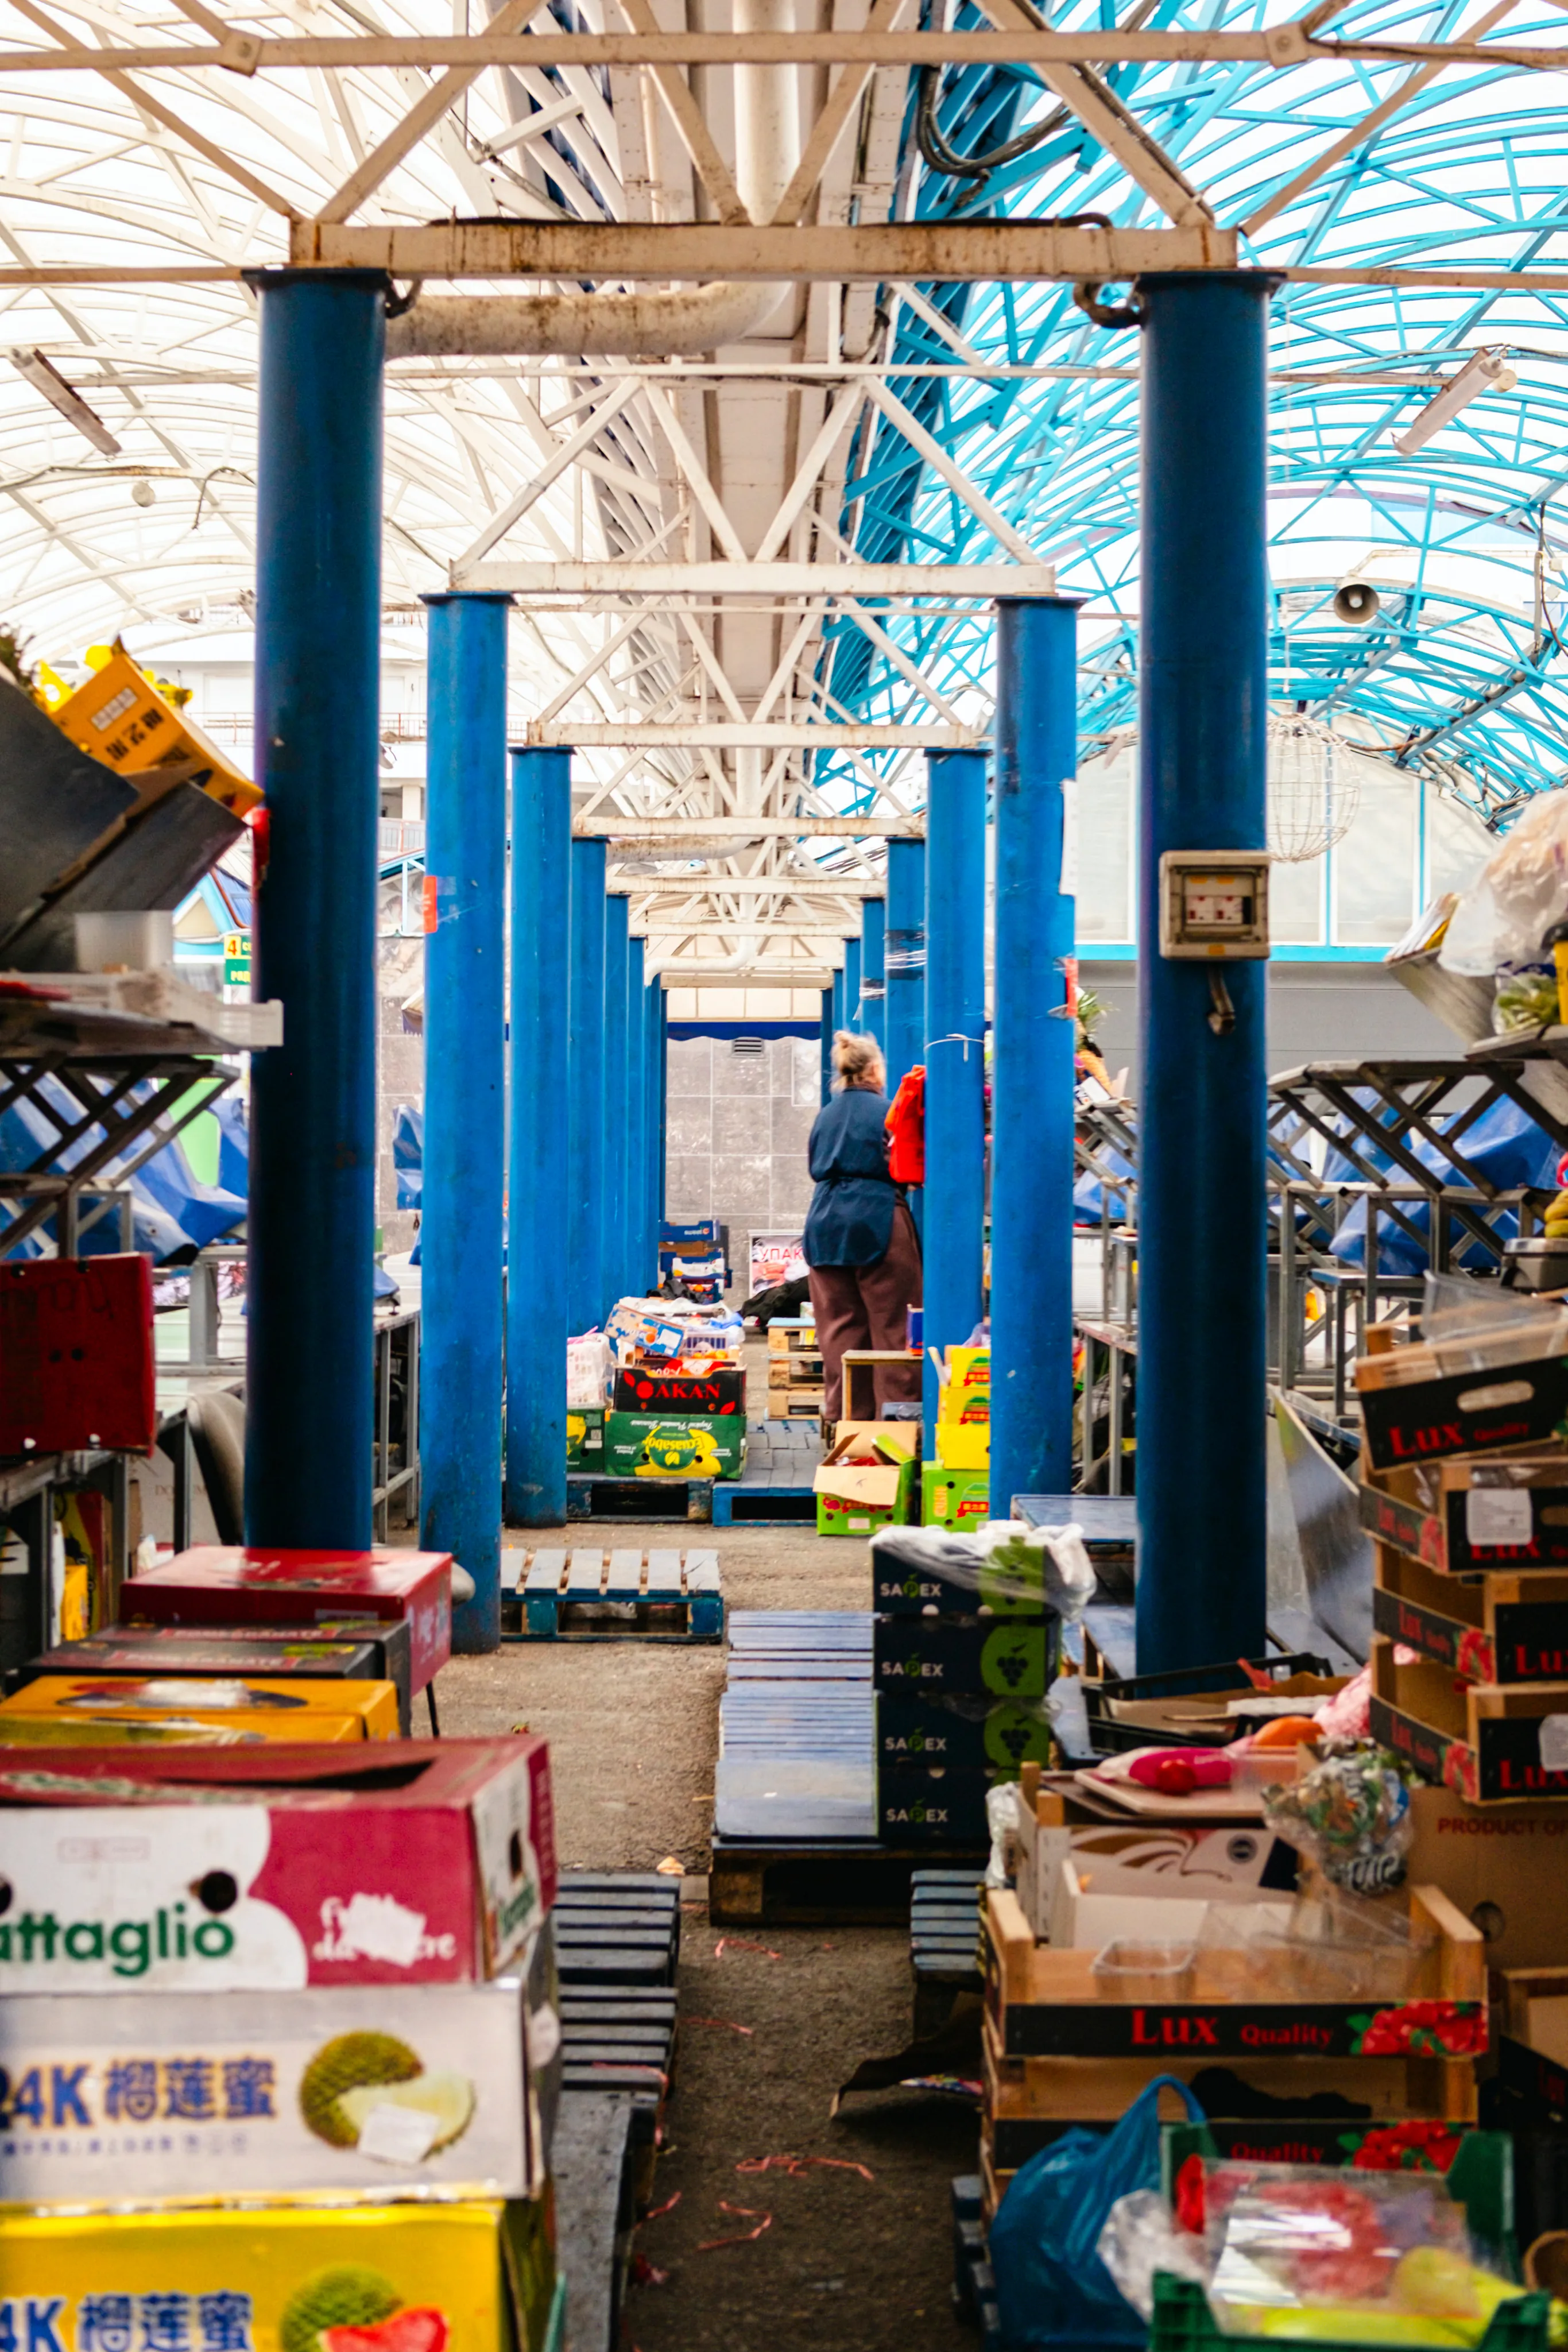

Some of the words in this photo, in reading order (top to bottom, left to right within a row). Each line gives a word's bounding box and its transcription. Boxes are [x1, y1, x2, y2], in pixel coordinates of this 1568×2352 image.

[227, 940, 237, 956] 4
[1389, 1422, 1465, 1457] Lux
[1515, 1645, 1568, 1674] Lu
[1438, 1817, 1536, 1836] PRODUCT
[1131, 2009, 1219, 2045] Lux
[1240, 2024, 1333, 2049] Quality
